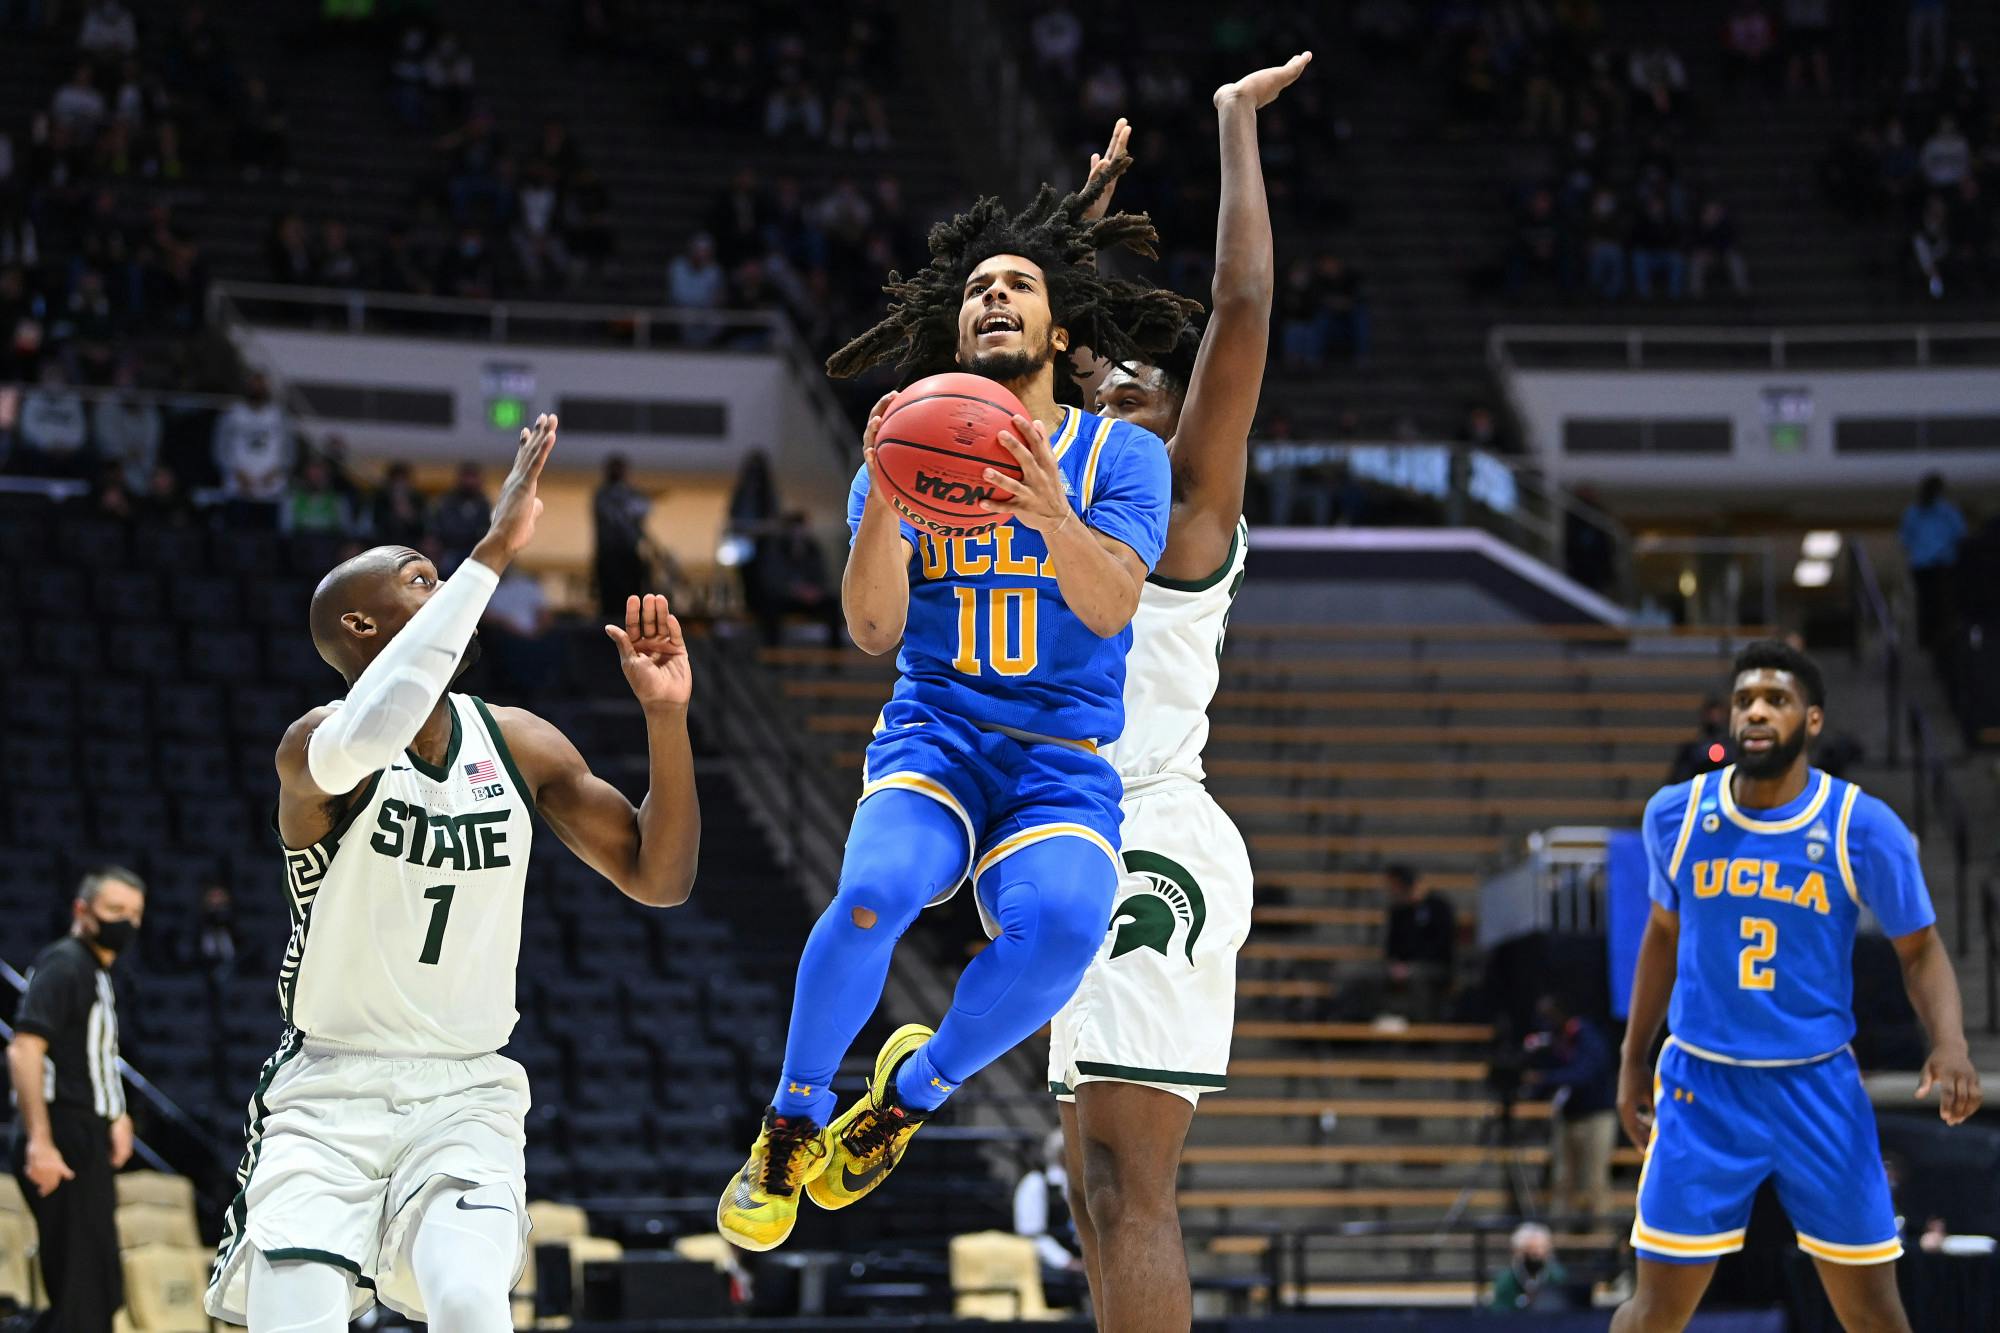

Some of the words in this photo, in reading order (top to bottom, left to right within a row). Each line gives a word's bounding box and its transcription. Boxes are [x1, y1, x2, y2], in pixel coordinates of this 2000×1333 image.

[915, 471, 995, 506] NCAA
[952, 586, 1038, 676] 10
[370, 798, 511, 871] STATE
[1693, 858, 1831, 915] UCLA
[418, 885, 456, 965] 1
[1739, 916, 1777, 990] 2
